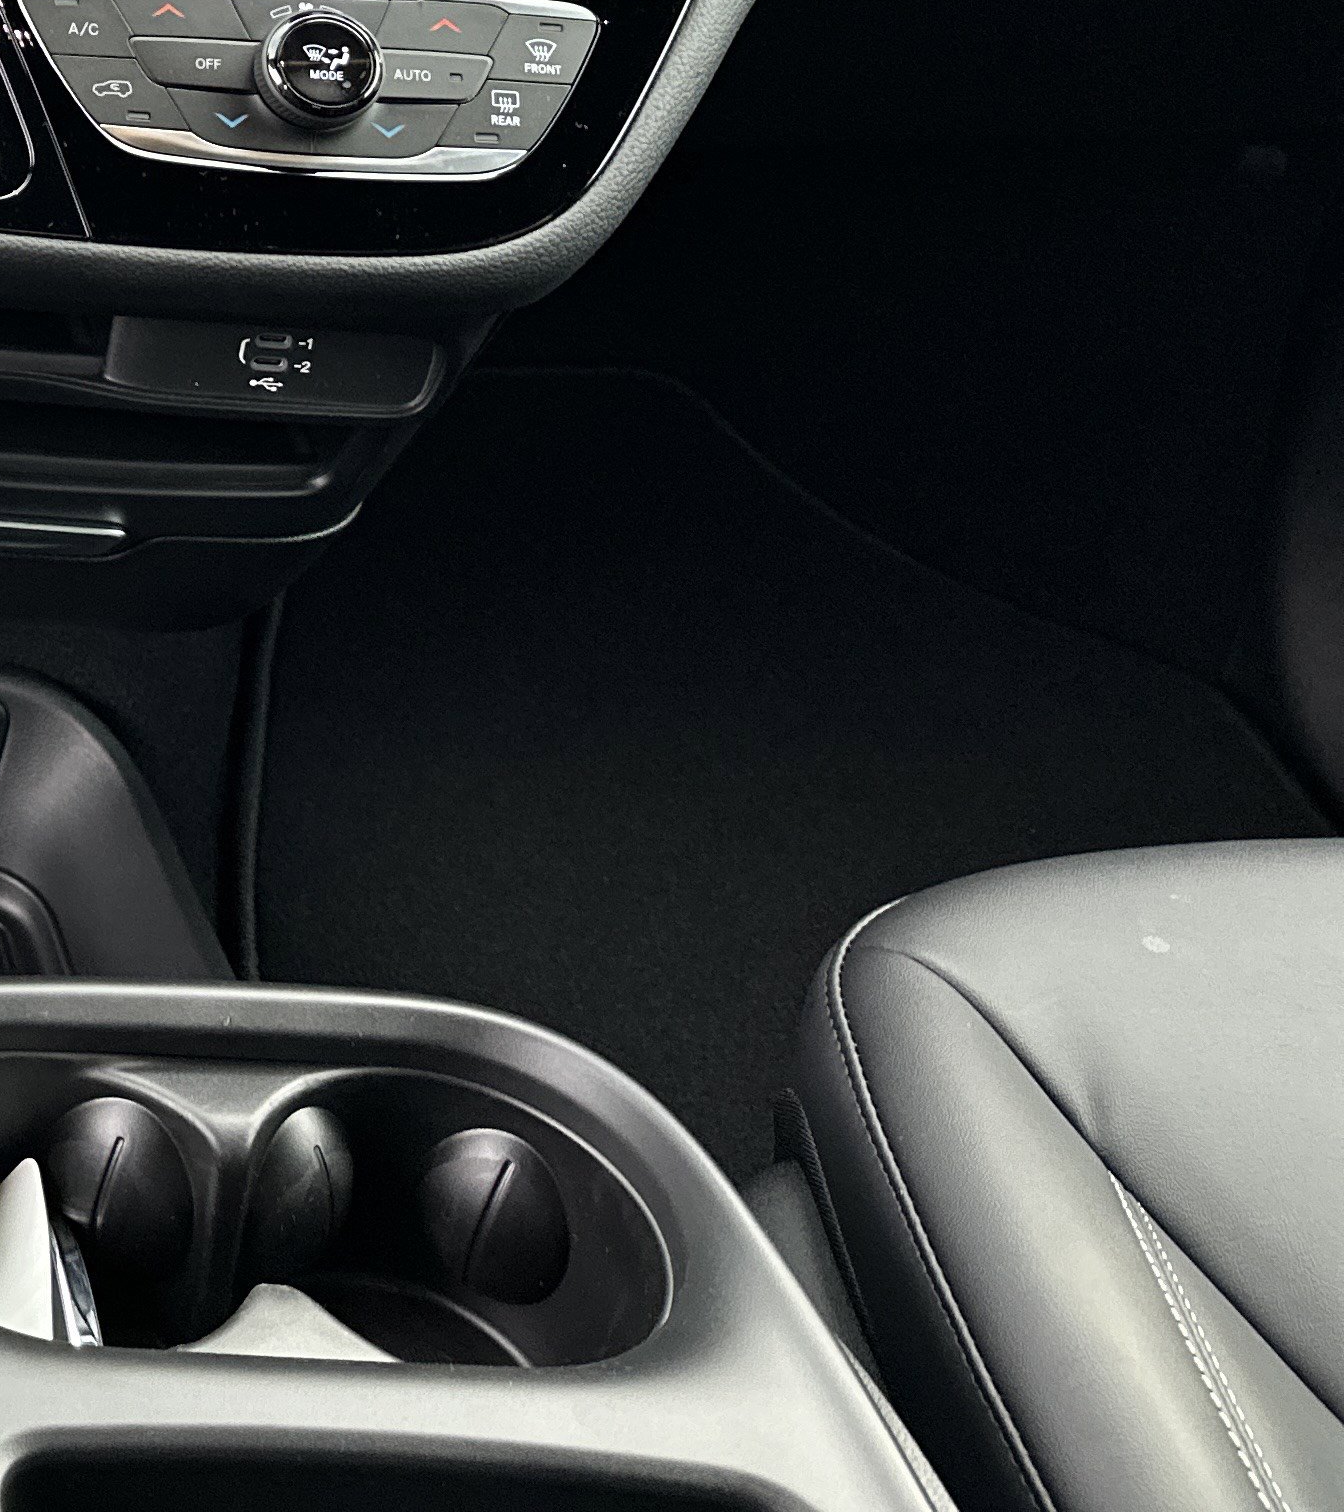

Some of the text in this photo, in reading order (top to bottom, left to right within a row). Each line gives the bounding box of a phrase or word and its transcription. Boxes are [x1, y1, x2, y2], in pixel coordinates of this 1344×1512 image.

[68, 21, 100, 37] A/C
[195, 57, 222, 71] OFF
[524, 62, 562, 76] FRONT
[309, 69, 344, 82] MODE
[393, 68, 432, 82] AUTO
[490, 114, 521, 127] REAR
